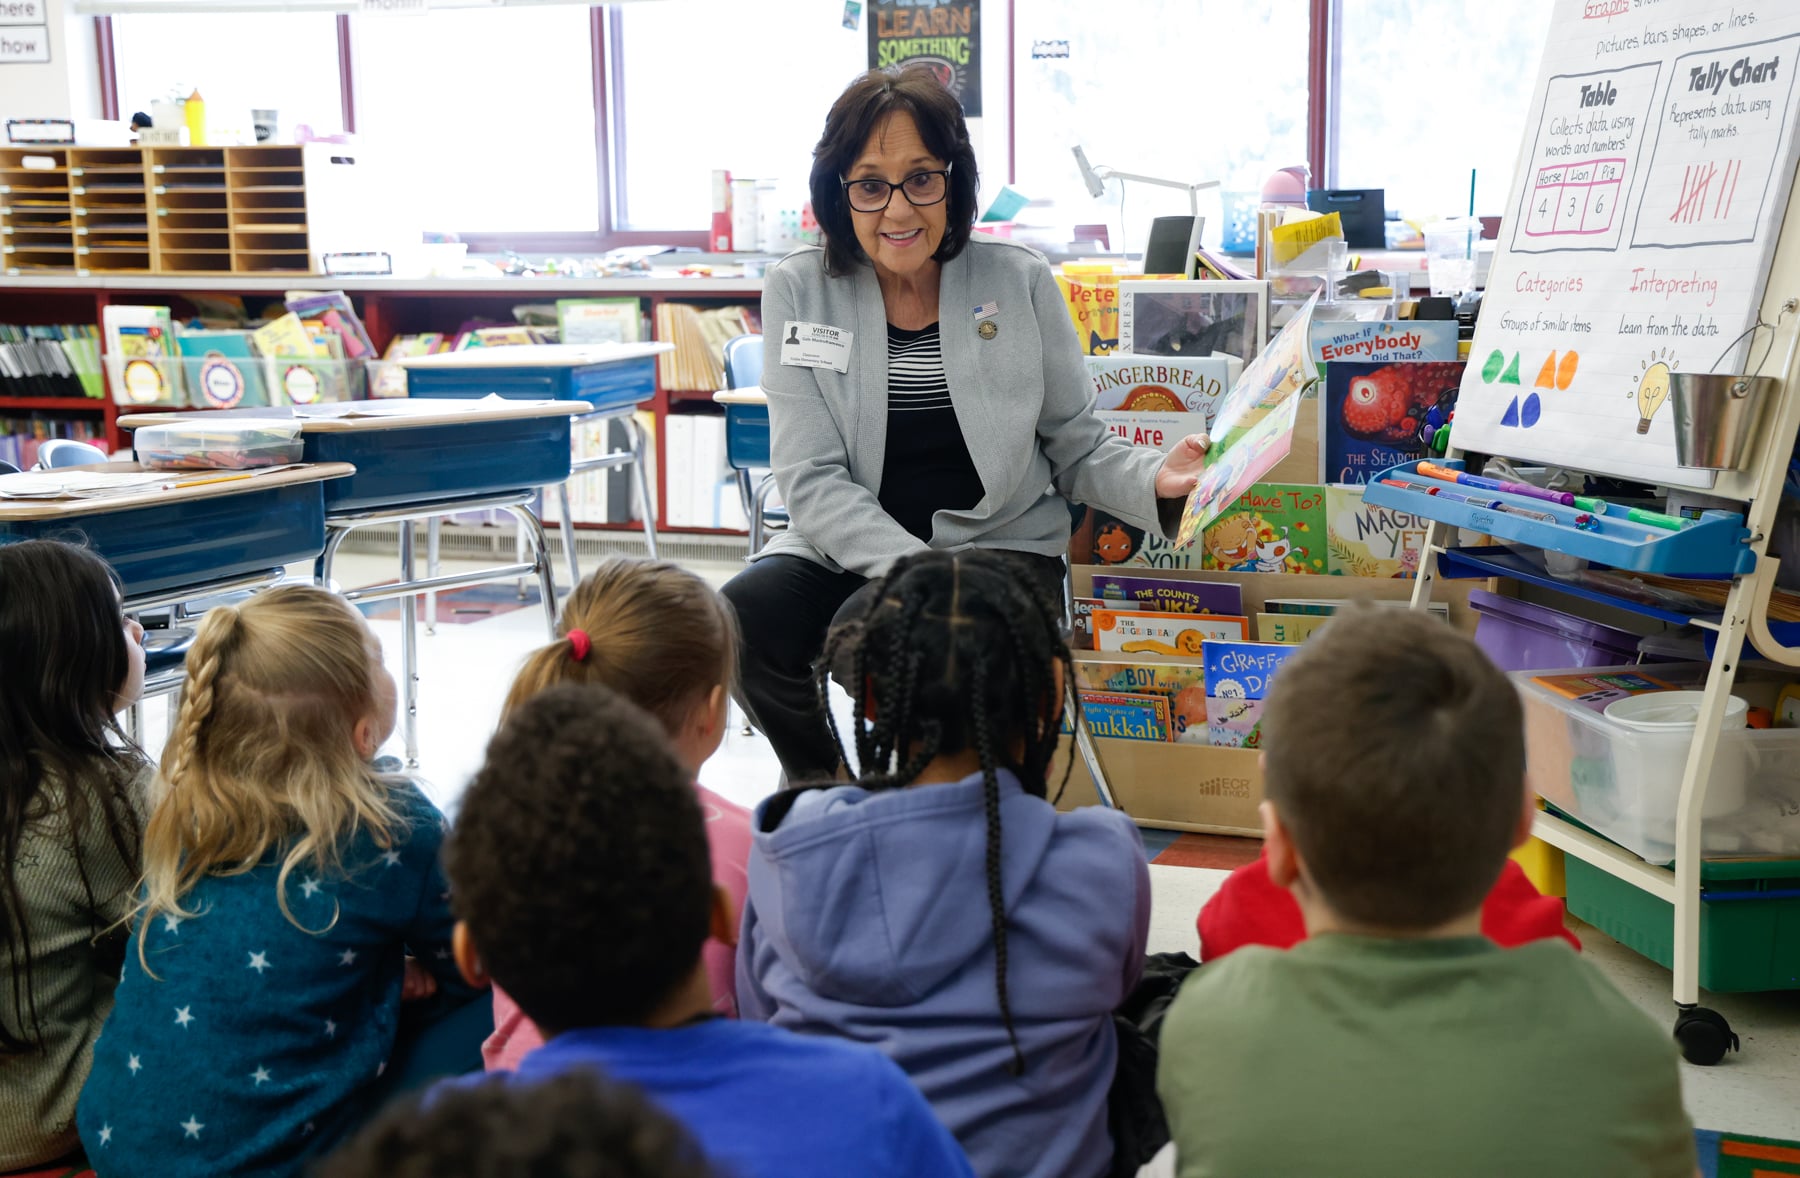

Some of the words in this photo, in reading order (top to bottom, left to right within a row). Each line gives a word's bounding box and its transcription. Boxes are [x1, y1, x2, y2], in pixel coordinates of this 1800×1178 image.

[877, 6, 971, 38] LEARN
[1712, 21, 1724, 32] or
[878, 36, 970, 68] SOMETHING
[1688, 61, 1729, 95] Tally
[1729, 56, 1779, 87] Chart
[1579, 80, 1617, 108] Table
[1670, 100, 1717, 127] Represents
[1721, 94, 1746, 116] data
[1550, 115, 1583, 136] Collects
[1586, 111, 1608, 134] data
[1611, 116, 1635, 139] using
[1688, 124, 1709, 148] tally
[1545, 138, 1571, 157] words
[1574, 134, 1592, 154] and
[1539, 171, 1562, 185] Horse
[1571, 169, 1589, 182] Lion
[1601, 164, 1616, 180] Pig
[1538, 198, 1547, 218] 4
[1567, 197, 1576, 217] 3
[1595, 194, 1604, 214] 6
[1070, 282, 1115, 303] Pete
[1515, 271, 1583, 301] Categories
[1629, 267, 1718, 307] Interpreting
[812, 327, 840, 337] VISITOR
[1500, 310, 1528, 335] Groups
[1530, 312, 1542, 332] of
[1543, 313, 1568, 332] similar
[1570, 314, 1591, 333] items
[1618, 314, 1642, 335] Learn
[1646, 315, 1668, 335] from
[1671, 314, 1688, 336] the
[1691, 315, 1719, 337] data
[1321, 332, 1421, 361] Everybody
[1333, 332, 1360, 345] What
[1363, 327, 1371, 338] If
[1372, 351, 1389, 361] Did
[1393, 351, 1423, 361] That?
[1185, 391, 1215, 414] Girl
[1133, 426, 1164, 446] Are
[1346, 453, 1366, 465] THE
[1240, 490, 1282, 509] Have
[1287, 491, 1323, 511] To?
[1143, 551, 1190, 569] YOU
[1134, 589, 1154, 600] THE
[1157, 588, 1200, 604] COUNT'S
[1210, 631, 1227, 640] BOY
[1125, 668, 1155, 687] BOY
[1064, 712, 1161, 739] nukkah
